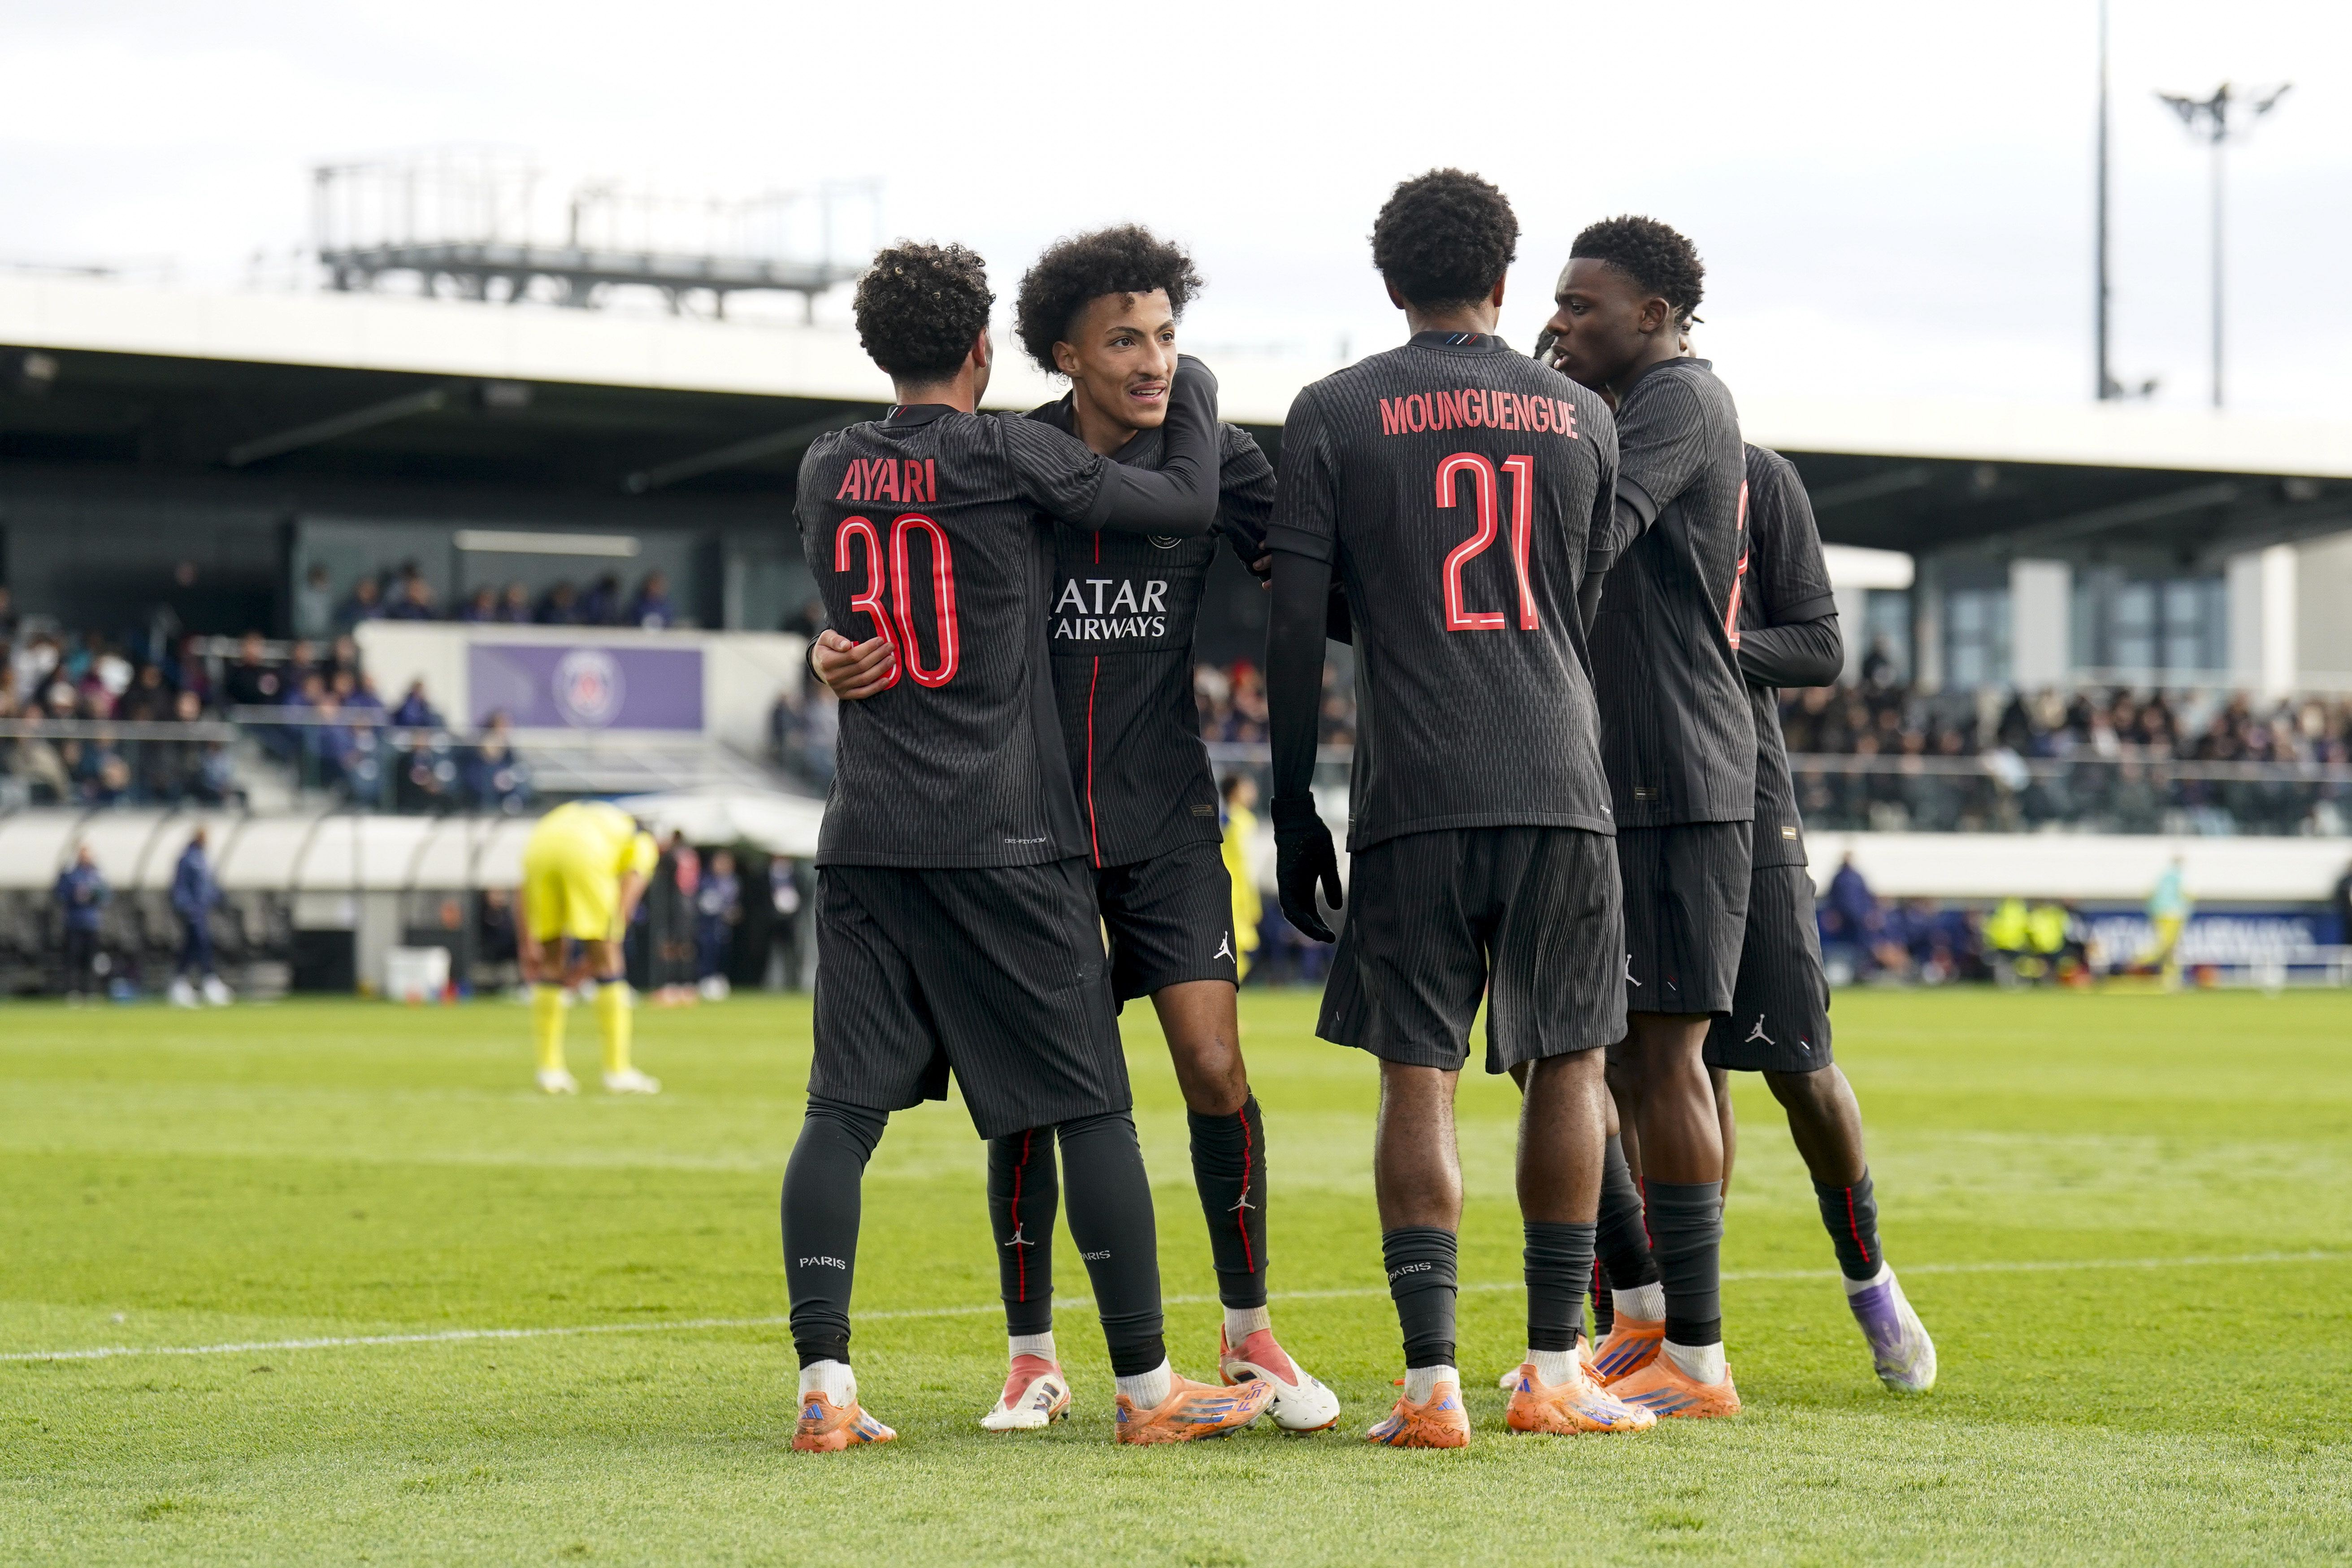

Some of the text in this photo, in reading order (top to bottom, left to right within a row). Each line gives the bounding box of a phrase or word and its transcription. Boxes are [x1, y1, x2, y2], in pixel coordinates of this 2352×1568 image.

[1380, 388, 1578, 439] MOUNGUENGUE
[835, 458, 936, 502] AYARI
[1436, 452, 1539, 632] 21
[835, 513, 959, 690] 30
[1048, 578, 1167, 621] ATAR
[1054, 616, 1165, 640] AIRWAYS
[799, 1256, 846, 1270] PARIS
[1389, 1262, 1431, 1282] PARIS
